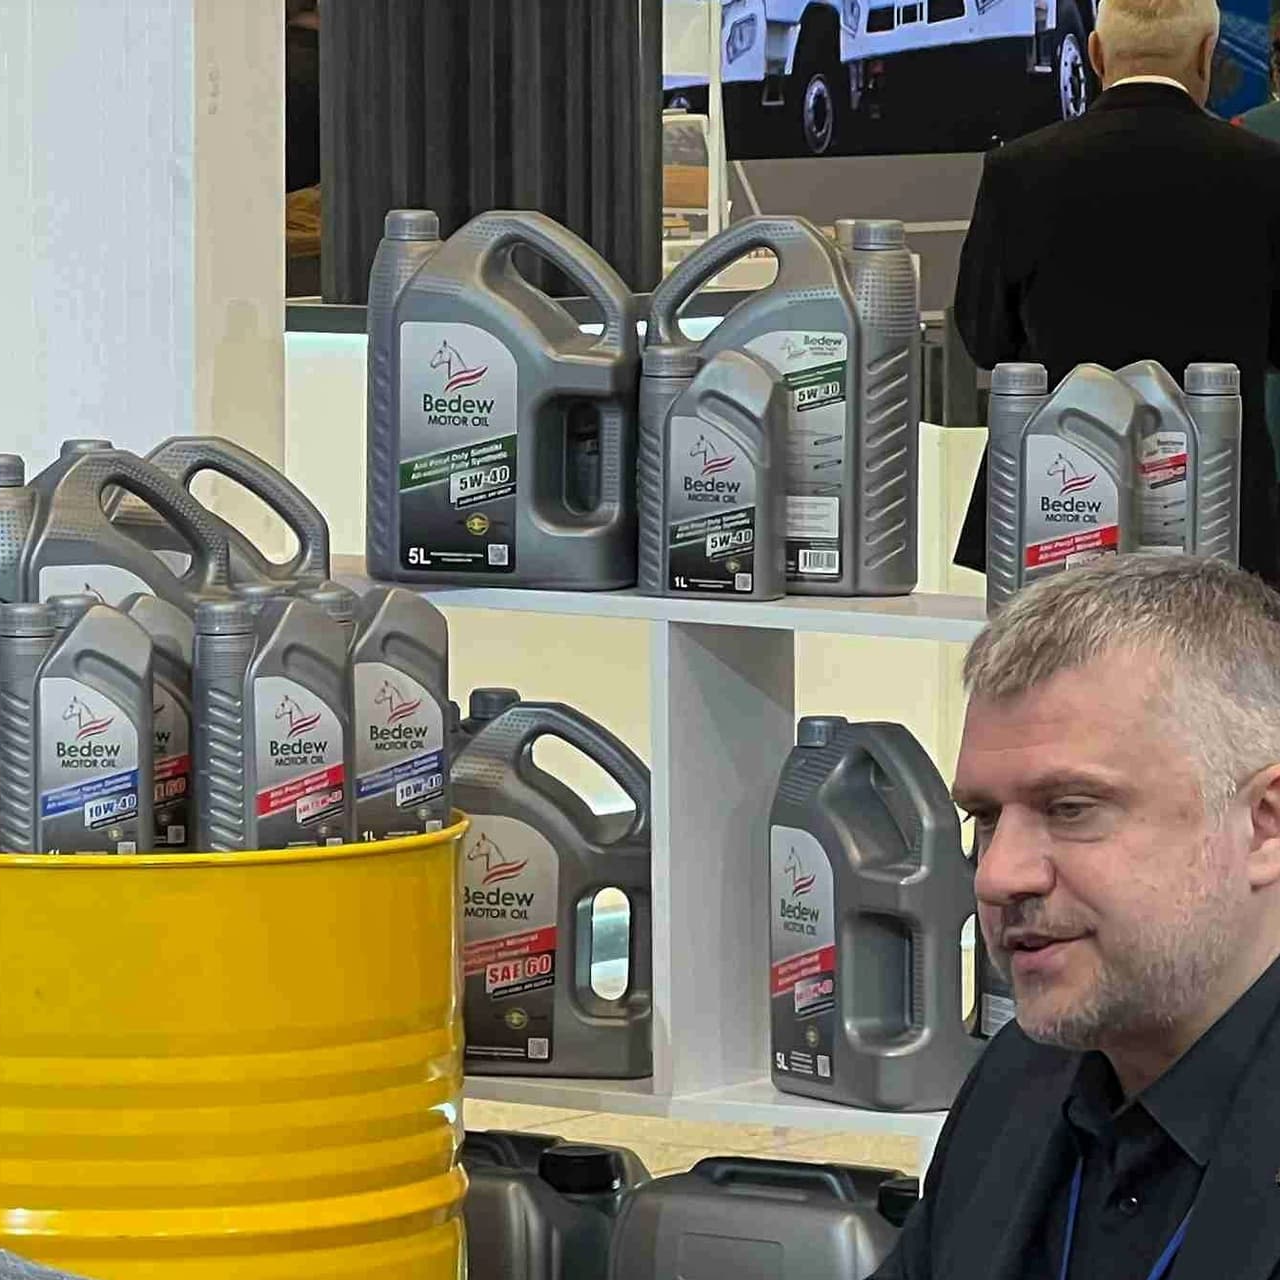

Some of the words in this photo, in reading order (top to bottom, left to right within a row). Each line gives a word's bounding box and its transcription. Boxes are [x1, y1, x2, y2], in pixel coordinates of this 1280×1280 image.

[423, 394, 495, 414] Bedew
[427, 416, 468, 427] MOTOR
[471, 416, 489, 427] OIL
[460, 466, 510, 491] 5W-40
[683, 476, 741, 493] Bedew
[1041, 496, 1102, 513] Bedew
[1045, 513, 1080, 523] MOTOR
[1082, 514, 1098, 524] OIL
[408, 547, 432, 565] 5L
[674, 576, 688, 588] 1L
[370, 724, 428, 740] Bedew
[56, 741, 121, 758] Bedew
[270, 739, 328, 756] Bedew
[375, 742, 408, 751] MOTOR
[411, 741, 425, 750] OIL
[61, 759, 97, 769] MOTOR
[101, 759, 117, 768] OIL
[275, 757, 309, 767] MOTOR
[311, 756, 325, 765] OIL
[89, 794, 137, 818] 10W-40
[464, 907, 507, 919] MOTOR
[510, 908, 529, 921] OIL
[780, 898, 820, 923] Bedew
[488, 963, 520, 986] SAE
[524, 954, 551, 978] 60
